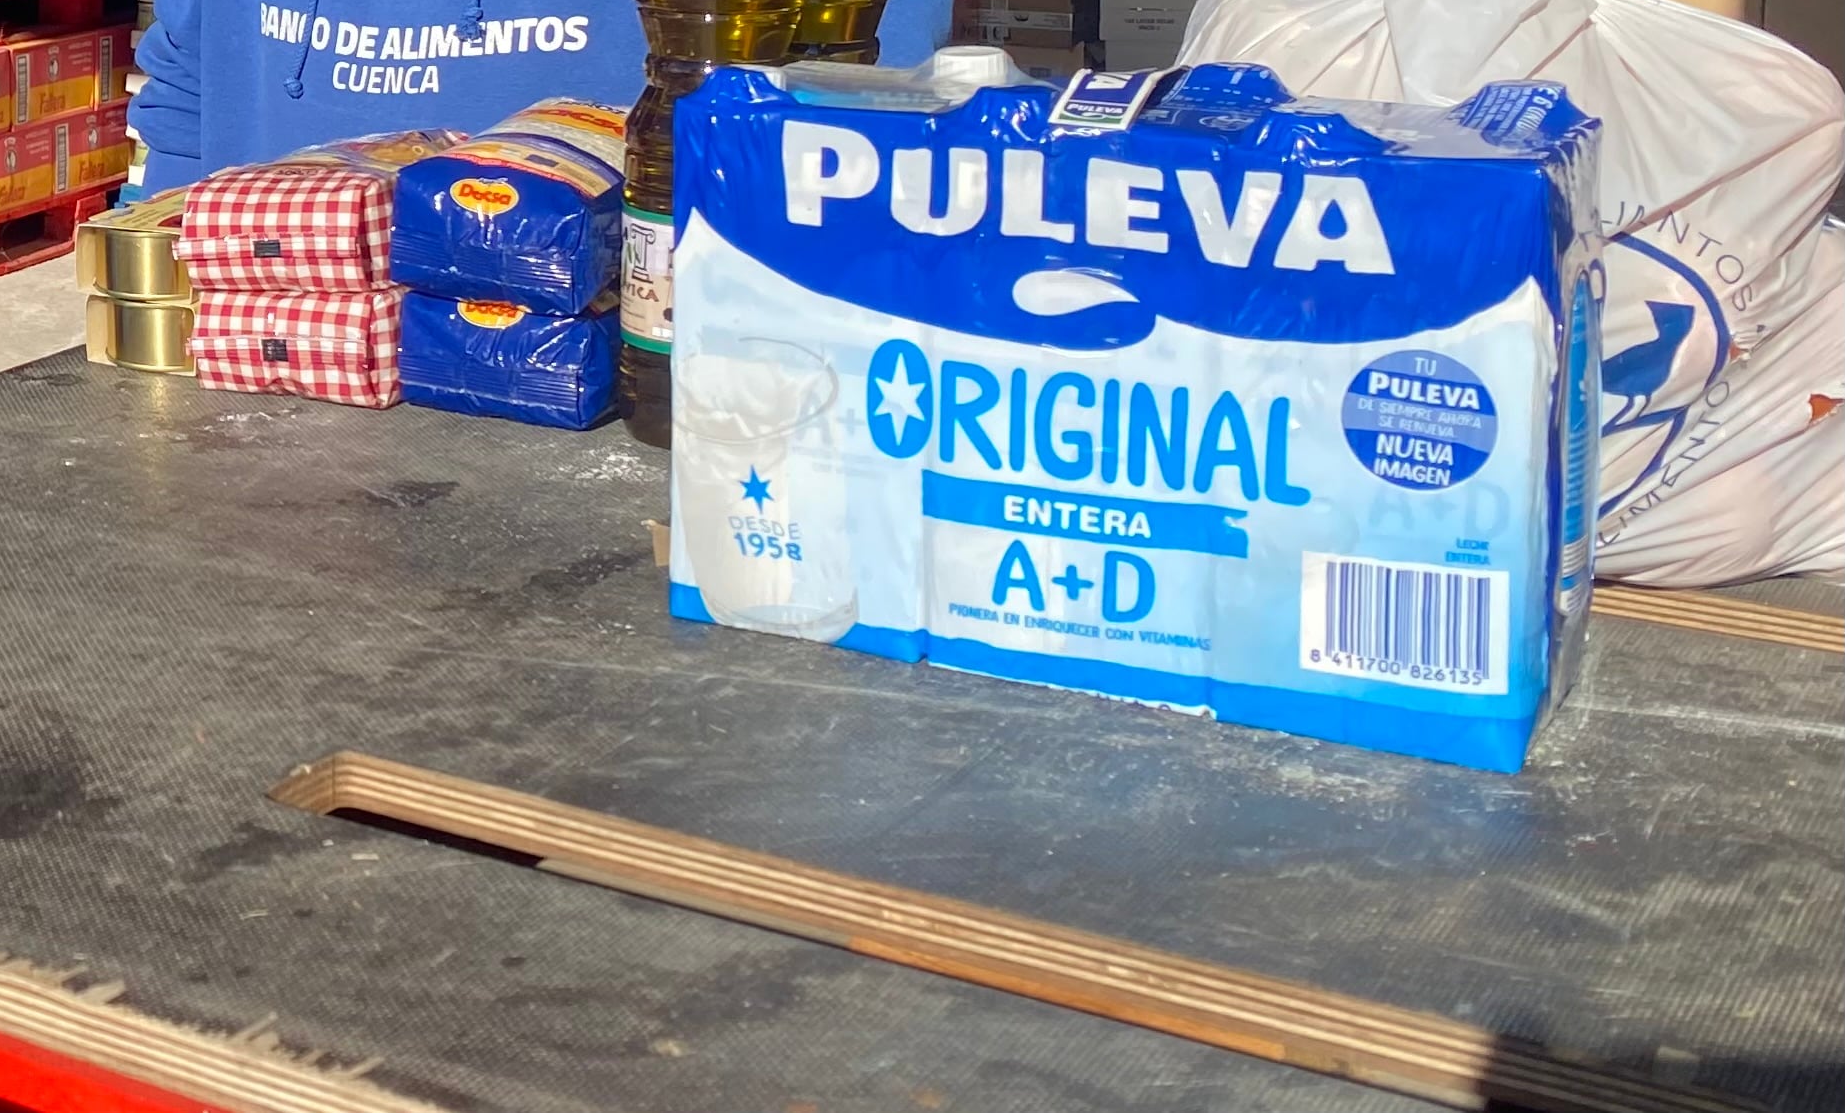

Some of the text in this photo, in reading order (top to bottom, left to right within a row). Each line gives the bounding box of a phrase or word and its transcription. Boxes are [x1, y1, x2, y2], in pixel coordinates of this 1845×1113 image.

[334, 21, 379, 60] DE
[332, 60, 441, 95] CUENCA
[1065, 102, 1124, 115] PULEVA
[459, 183, 512, 206] Docsa
[781, 120, 1395, 276] PULEVA
[1414, 357, 1437, 376] TU
[1368, 370, 1480, 410] PULEVA
[867, 338, 1312, 507] ORIGINAL
[1358, 397, 1483, 429] DE SIEMPRE AHORA
[1378, 415, 1456, 438] SE RENUEVA
[1376, 433, 1455, 467] NUEVA
[1373, 458, 1452, 487] IMAGEN
[728, 515, 801, 540] DESDE
[1003, 494, 1152, 539] ENTERA
[733, 532, 803, 562] 1958
[991, 539, 1156, 623] A+D
[947, 602, 1213, 652] PIONERA EN ENRIQUECER CON VITAMINAS
[1309, 649, 1483, 686] 8 411700 826135
